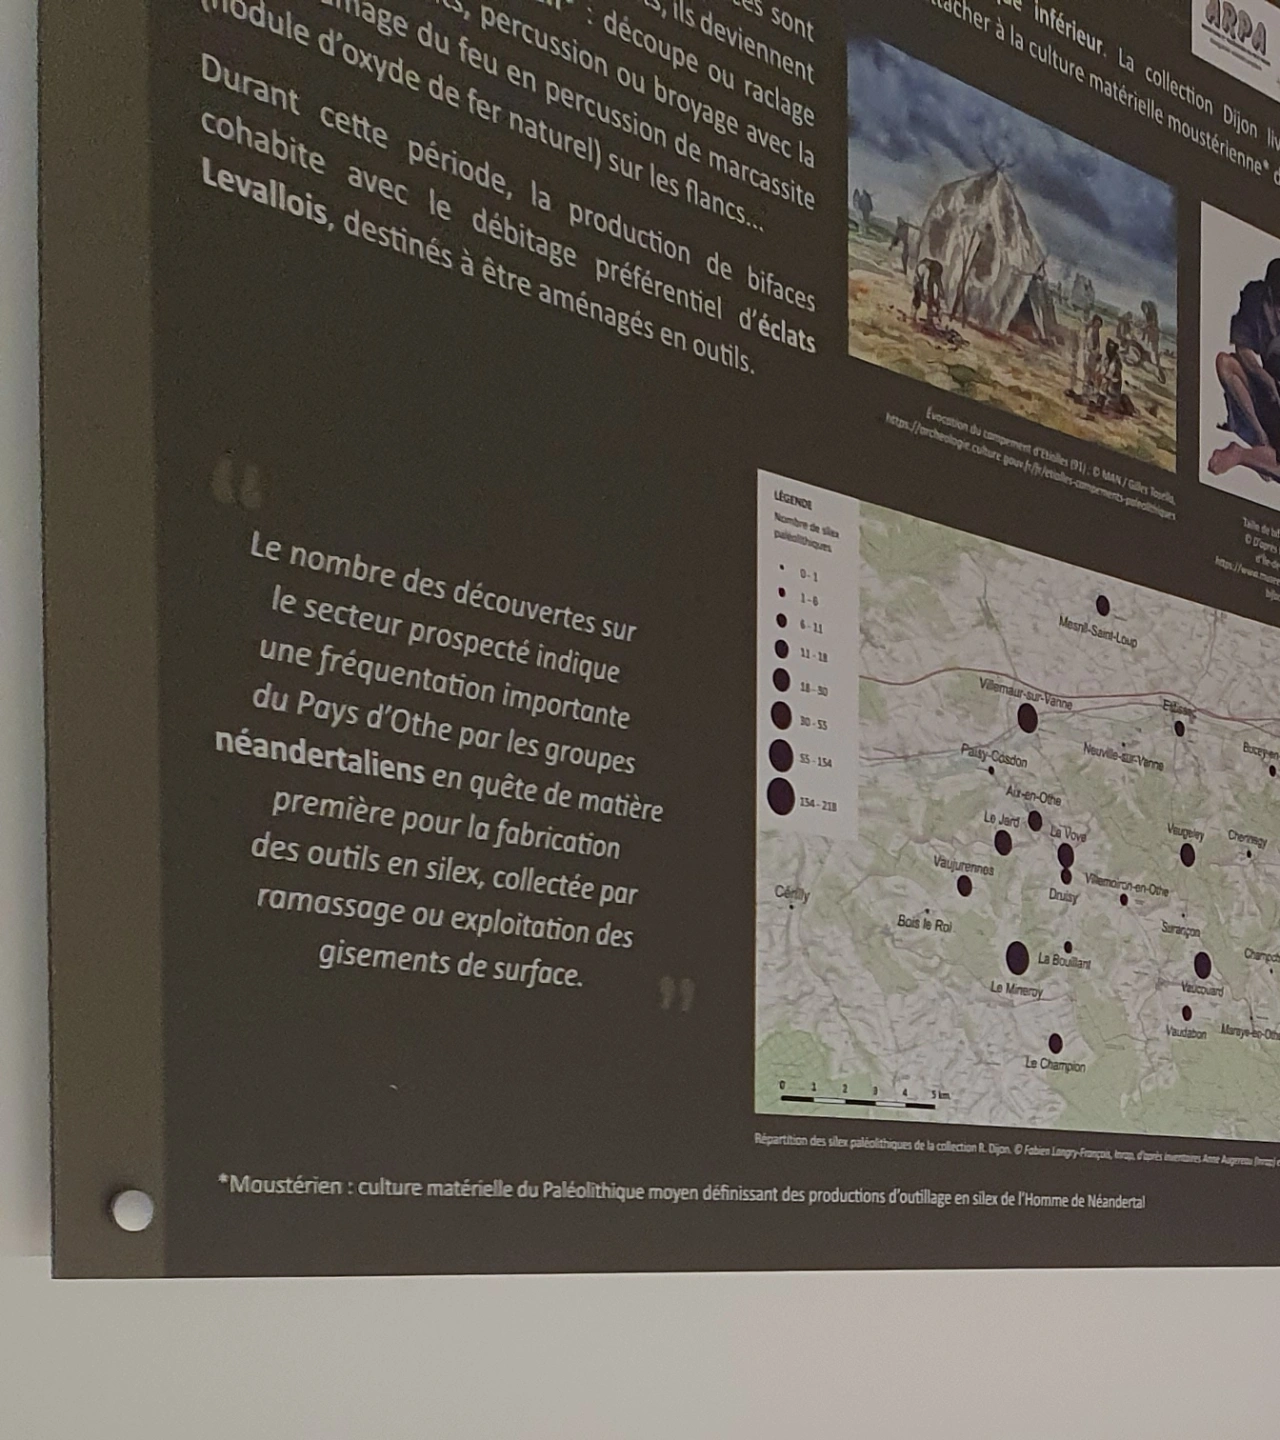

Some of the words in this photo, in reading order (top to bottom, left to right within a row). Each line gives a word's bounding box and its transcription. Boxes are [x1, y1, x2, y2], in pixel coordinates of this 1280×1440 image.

[603, 9, 699, 74] découpe
[708, 62, 735, 91] ou
[744, 78, 815, 128] raclage
[673, 0, 696, 29] ils
[700, 10, 815, 86] deviennent
[770, 5, 815, 44] sont
[995, 16, 1005, 42] à
[1010, 23, 1024, 52] la
[1029, 40, 1085, 84] culture
[1089, 72, 1164, 126] matérielle
[1034, 0, 1107, 59] inférieur.
[1118, 46, 1134, 73] La
[1145, 65, 1213, 116] collection
[1223, 102, 1258, 139] Dijon
[1205, 0, 1267, 56] ARPA
[317, 32, 421, 92] d'oxyde
[428, 76, 460, 109] de
[466, 88, 502, 124] fer
[509, 110, 602, 172] naturel)
[608, 152, 644, 182] sur
[649, 161, 680, 198] les
[417, 20, 450, 57] du
[458, 34, 498, 77] feu
[506, 63, 537, 93] en
[545, 79, 667, 149] percussion
[674, 131, 702, 163] de
[708, 149, 815, 212] marcassite
[480, 4, 608, 78] percussion
[616, 65, 645, 95] ou
[654, 73, 739, 136] broyage
[746, 123, 792, 160] avec
[798, 139, 815, 169] la
[201, 51, 301, 117] Durant
[320, 105, 389, 150] cette
[408, 138, 513, 202] période,
[531, 178, 551, 212] la
[569, 201, 691, 266] production
[706, 250, 733, 282] de
[747, 263, 816, 313] bifaces
[201, 111, 326, 176] cohabite
[347, 165, 409, 207] avec
[429, 186, 452, 222] le
[472, 206, 577, 269] débitage
[595, 257, 722, 321] préférentiel
[738, 306, 816, 354] d'éclats
[202, 155, 335, 233] Levallois,
[343, 208, 453, 270] destinés
[460, 247, 474, 278] à
[482, 255, 532, 298] être
[538, 282, 654, 340] aménagés
[660, 326, 687, 352] en
[692, 337, 755, 376] outils.
[250, 529, 282, 562] Le
[289, 544, 396, 589] nombre
[402, 566, 447, 600] des
[453, 578, 596, 635] découvertes
[600, 618, 638, 643] sur
[271, 583, 297, 615] le
[303, 598, 404, 637] secteur
[407, 621, 531, 665] prospecté
[536, 642, 621, 684] indique
[252, 681, 289, 713] du
[296, 689, 359, 729] Pays
[366, 702, 453, 743] d'Othe
[458, 726, 502, 751] par
[506, 727, 540, 758] les
[544, 741, 636, 776] groupes
[259, 638, 313, 668] une
[315, 643, 496, 704] fréquentation
[502, 681, 631, 731] importante
[215, 726, 426, 785] néandertaliens
[432, 767, 463, 790] en
[469, 771, 538, 803] quête
[543, 781, 573, 809] de
[578, 791, 664, 823] matière
[251, 829, 300, 863] des
[307, 843, 381, 873] outils
[387, 855, 419, 878] en
[424, 855, 485, 891] silex,
[492, 865, 595, 901] collectée
[598, 883, 639, 908] par
[271, 790, 396, 828] première
[401, 810, 463, 837] pour
[467, 812, 490, 841] la
[492, 817, 621, 860] fabrication
[257, 887, 406, 928] ramassage
[412, 906, 445, 928] ou
[450, 907, 590, 945] exploitation
[595, 920, 634, 949] des
[319, 938, 451, 975] gisements
[457, 950, 488, 979] de
[492, 956, 583, 989] surface.
[897, 914, 920, 930] Bois
[922, 917, 932, 931] le
[934, 918, 953, 934] Roi
[1025, 1055, 1038, 1069] Le
[1040, 1057, 1086, 1074] Champion
[357, 1176, 424, 1197] culture
[426, 1178, 514, 1199] matérielle
[516, 1179, 539, 1199] du
[542, 1179, 645, 1204] Paléolithique
[648, 1186, 699, 1205] moyen
[702, 1183, 779, 1203] définissant
[781, 1184, 806, 1203] des
[808, 1186, 886, 1206] productions
[888, 1187, 952, 1209] d'outillage
[954, 1192, 970, 1206] en
[972, 1190, 998, 1207] silex
[1000, 1190, 1016, 1207] de
[1017, 1190, 1070, 1208] l'Homme
[1070, 1192, 1086, 1209] de
[1087, 1192, 1146, 1210] Néandertal
